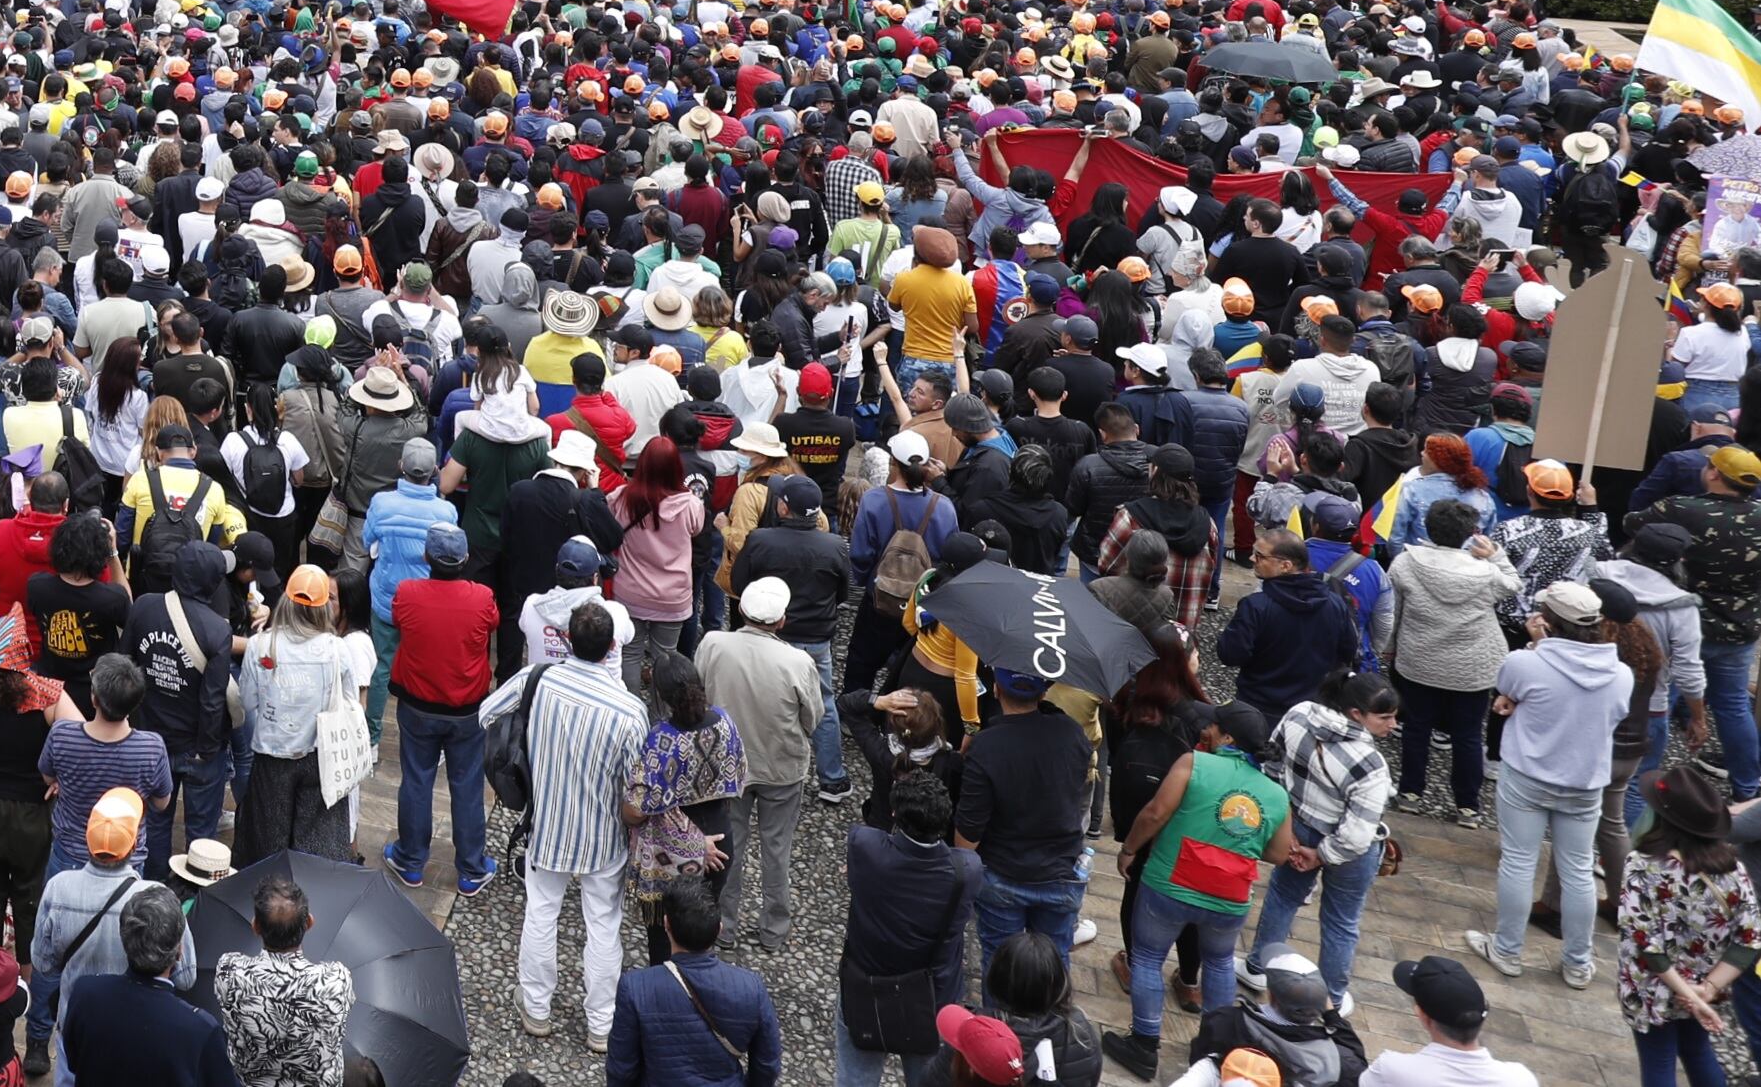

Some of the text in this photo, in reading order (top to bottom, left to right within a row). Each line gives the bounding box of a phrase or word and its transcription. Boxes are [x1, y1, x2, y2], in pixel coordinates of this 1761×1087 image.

[1721, 189, 1761, 204] NUESTR
[791, 436, 841, 446] UTIBAC
[139, 638, 150, 654] NO
[148, 631, 180, 649] PLACE
[330, 728, 349, 744] NO
[333, 751, 348, 763] TU
[335, 764, 359, 783] SOY
